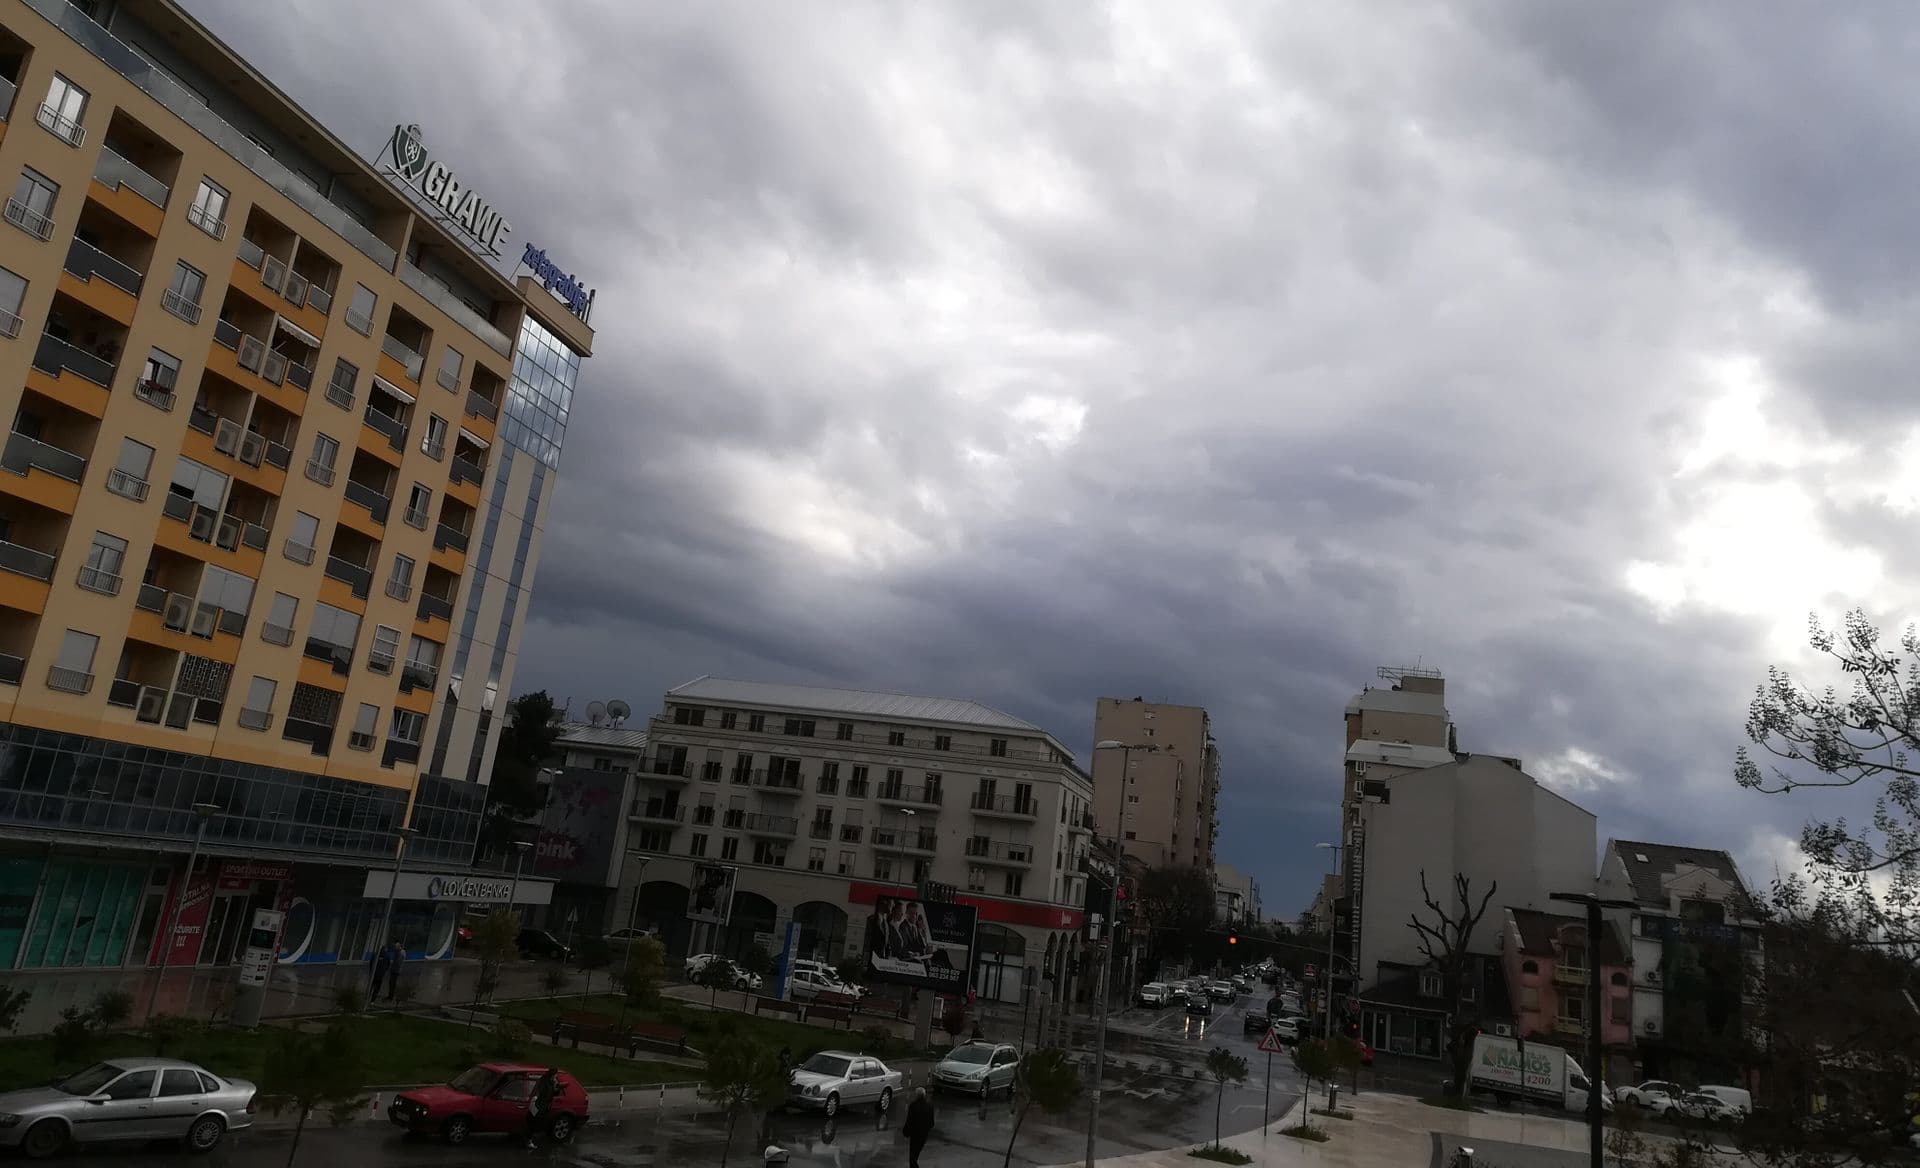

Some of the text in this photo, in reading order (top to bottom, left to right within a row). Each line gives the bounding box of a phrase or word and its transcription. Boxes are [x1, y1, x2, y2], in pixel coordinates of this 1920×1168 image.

[422, 161, 512, 256] GRAWE
[260, 864, 289, 878] OUTLET
[479, 883, 511, 898] BANKA
